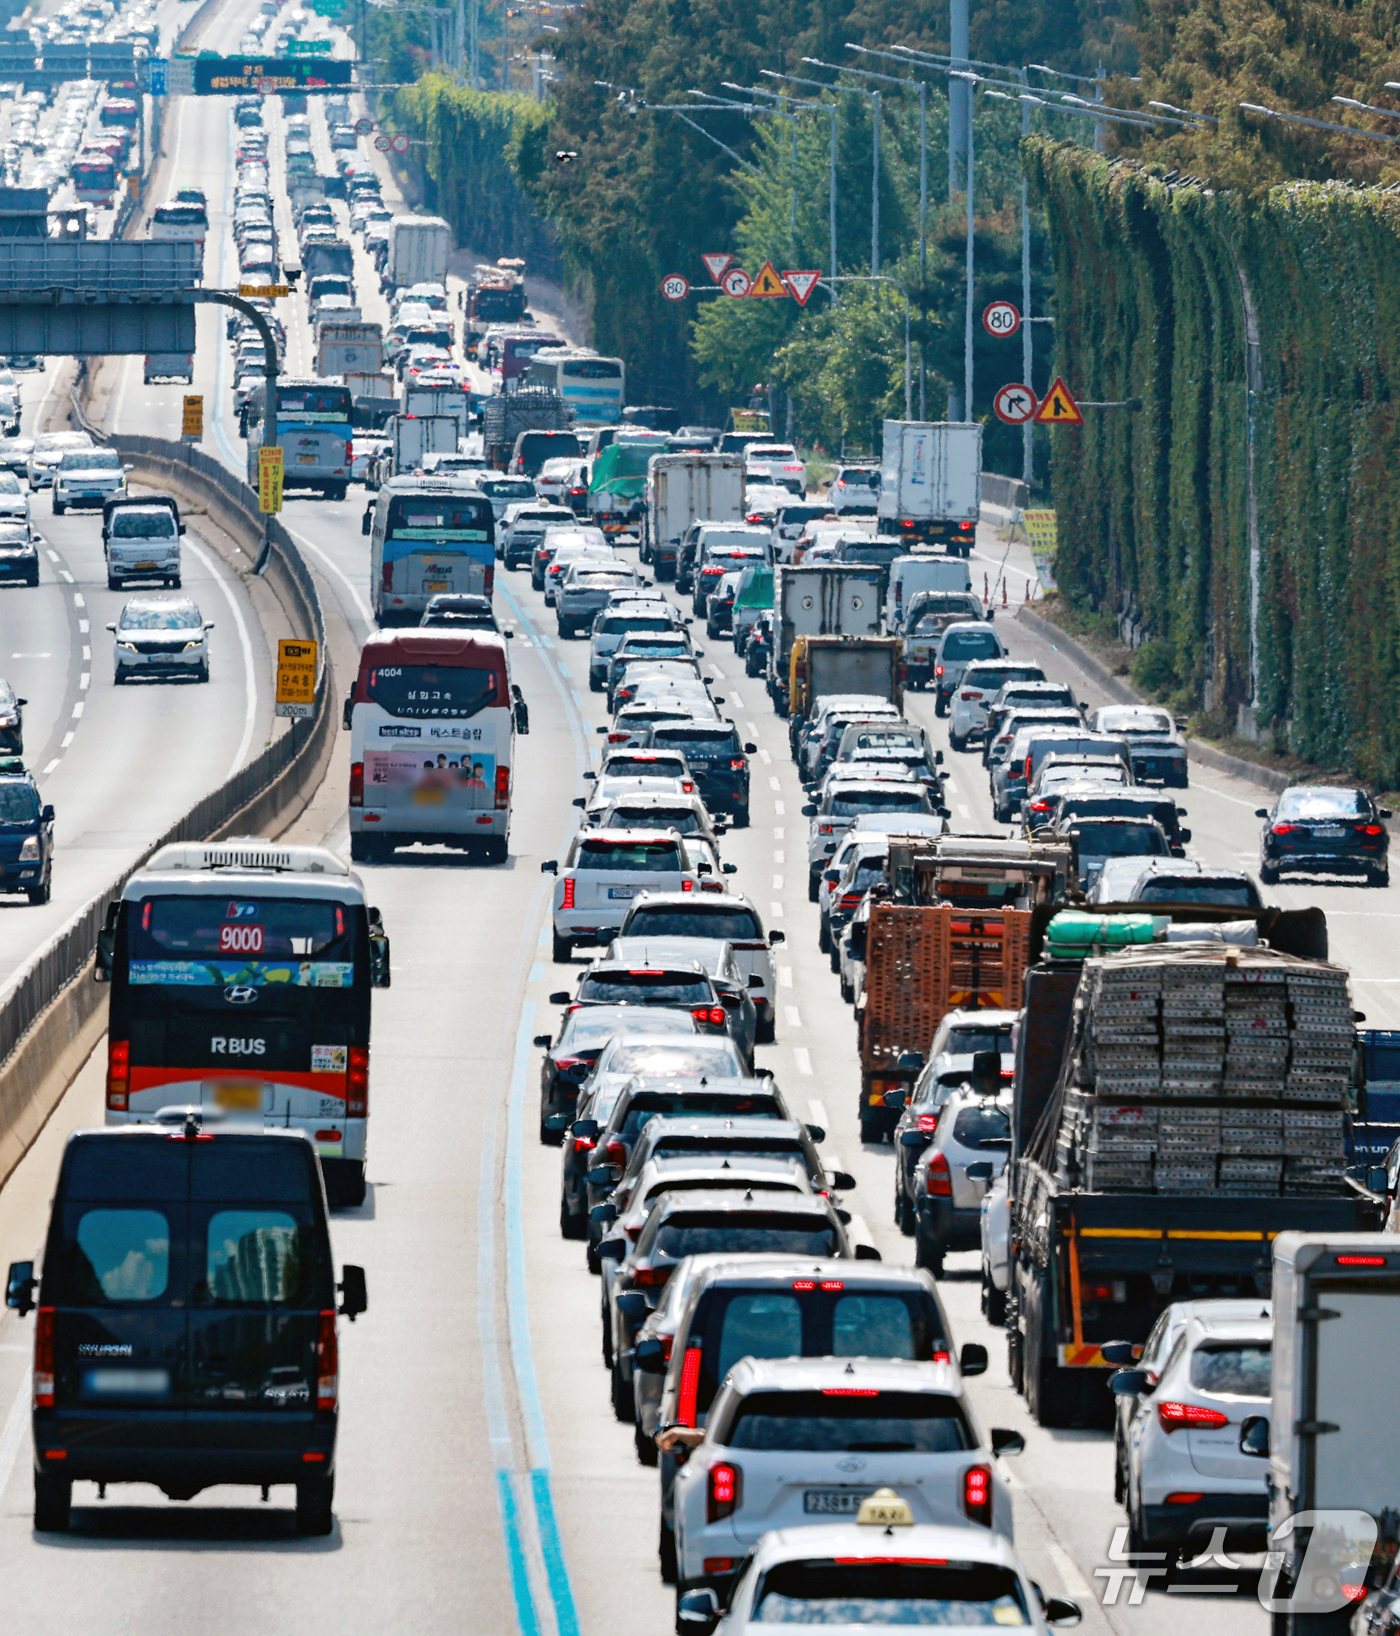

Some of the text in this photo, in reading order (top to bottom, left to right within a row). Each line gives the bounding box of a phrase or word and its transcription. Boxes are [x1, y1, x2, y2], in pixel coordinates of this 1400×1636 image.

[667, 281, 682, 295] 80
[991, 311, 1013, 328] 80
[378, 668, 402, 677] 4004
[282, 674, 309, 687] 단속중
[282, 705, 307, 715] 200m
[430, 727, 482, 741] 베스트슬립
[221, 926, 262, 951] 9000
[229, 1037, 266, 1055] BUS
[869, 1509, 905, 1521] TAXI
